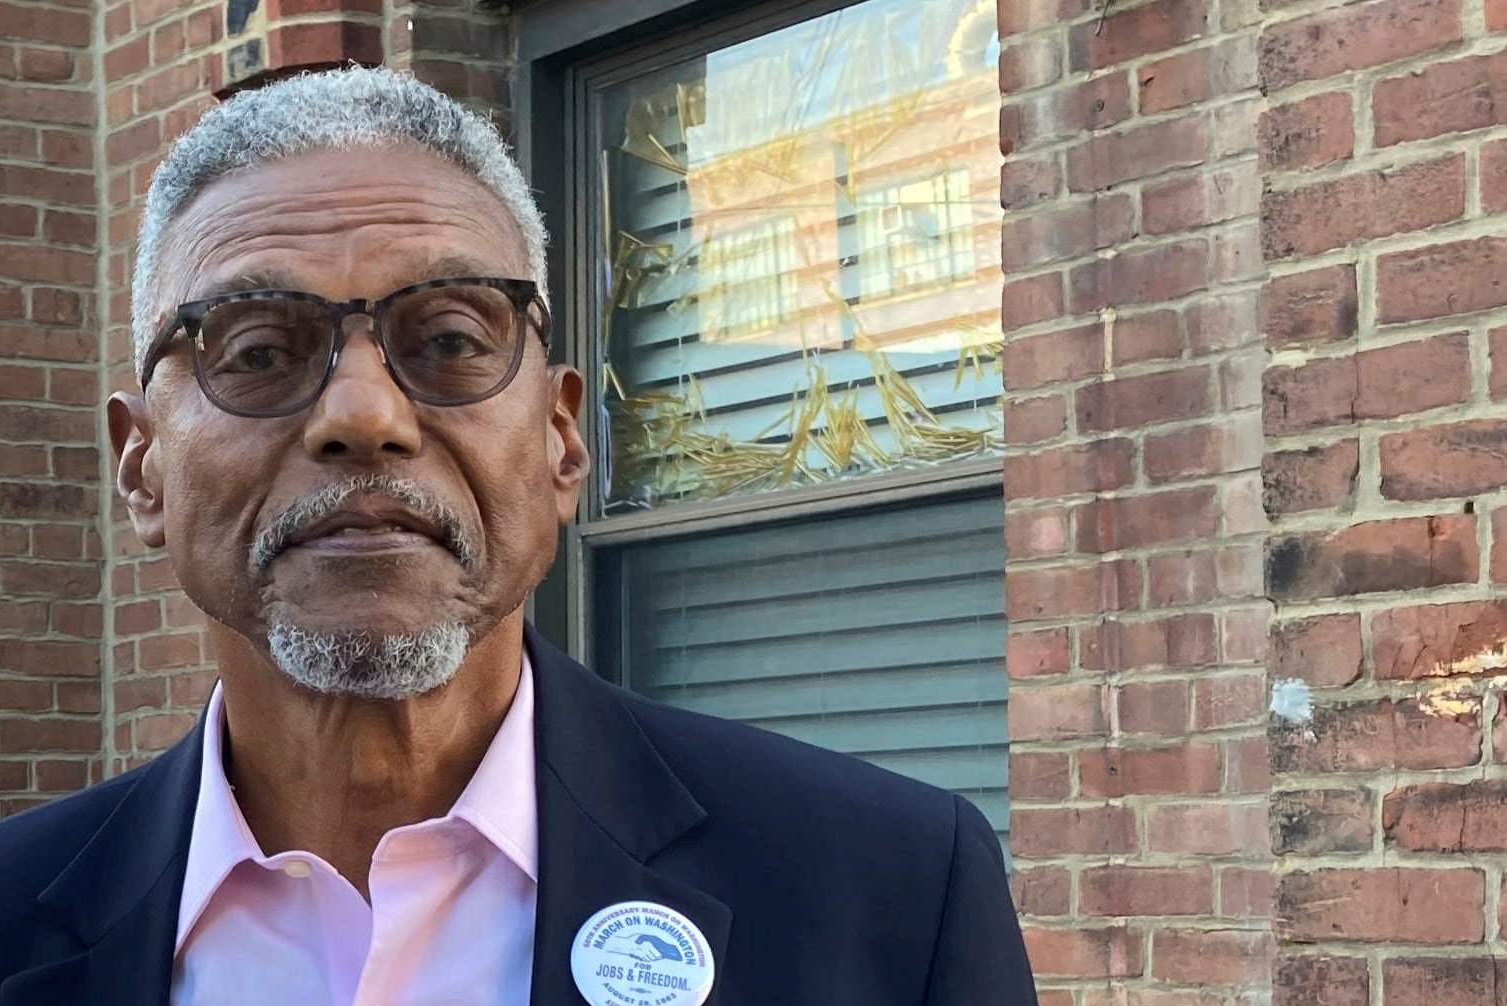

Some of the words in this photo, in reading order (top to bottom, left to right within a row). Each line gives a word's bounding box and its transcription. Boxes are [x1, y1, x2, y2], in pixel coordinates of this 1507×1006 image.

[592, 907, 639, 932] ANNIVERSARY
[593, 919, 624, 950] MARCH
[624, 915, 641, 926] ON
[644, 916, 696, 966] WASHINGTON
[596, 963, 623, 980] JOBS
[627, 968, 634, 982] &
[634, 962, 652, 970] FOR
[602, 982, 636, 1006] AUGUST
